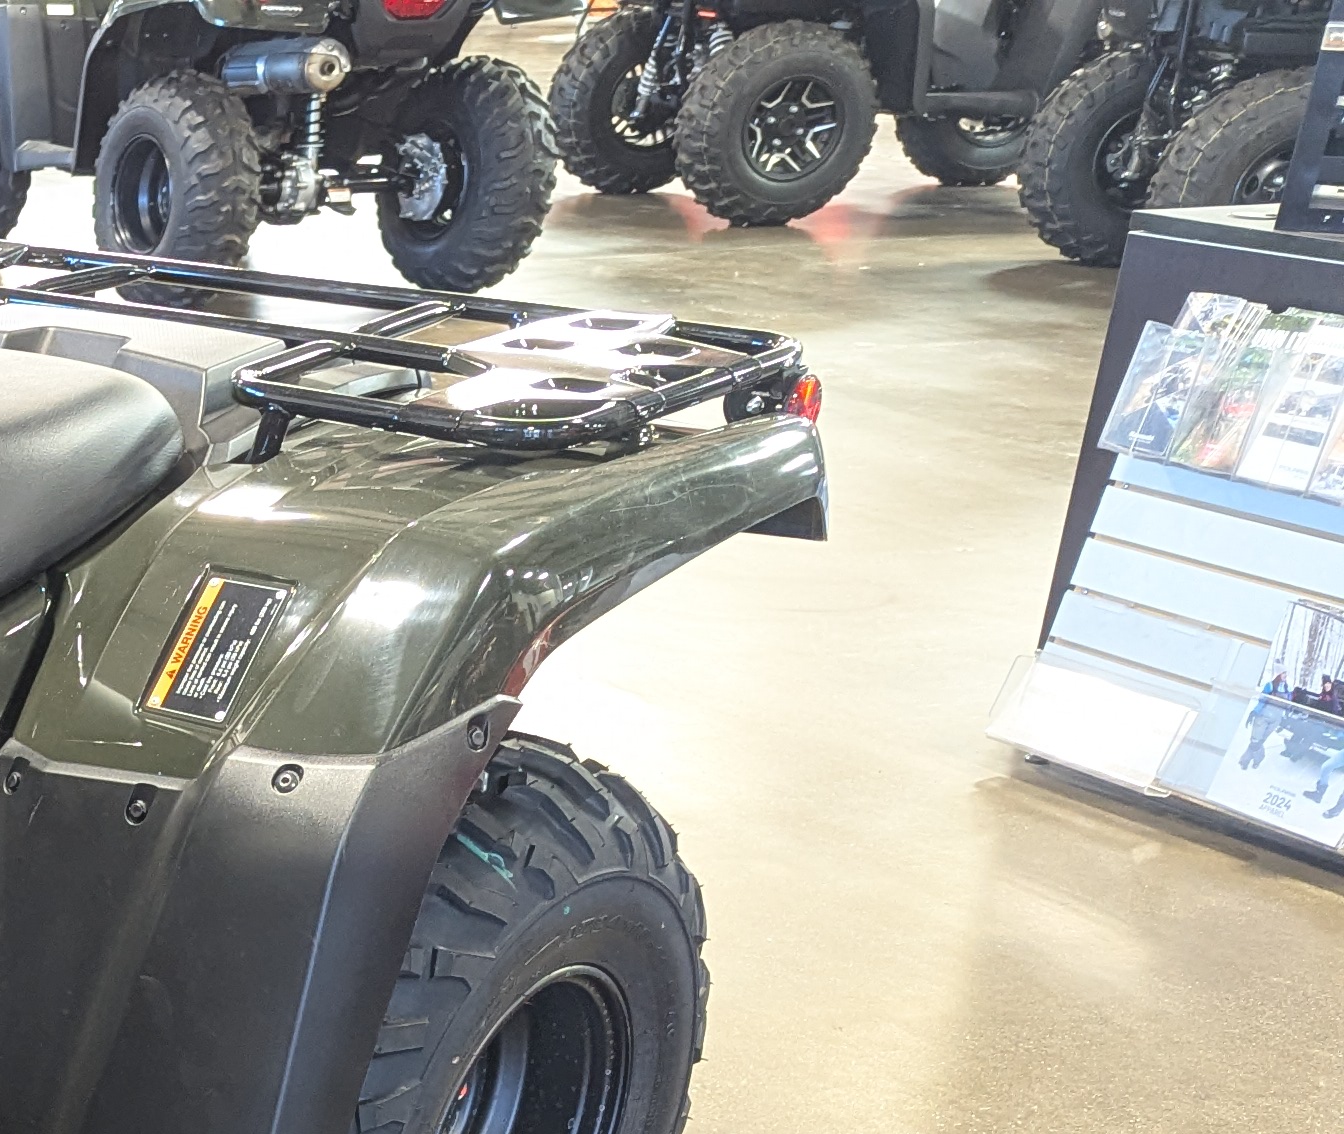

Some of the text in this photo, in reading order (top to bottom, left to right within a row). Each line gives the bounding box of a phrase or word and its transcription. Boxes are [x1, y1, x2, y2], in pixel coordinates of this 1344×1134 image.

[170, 605, 208, 664] WARNING
[1258, 803, 1285, 819] APPAREL
[1262, 792, 1292, 812] 2024
